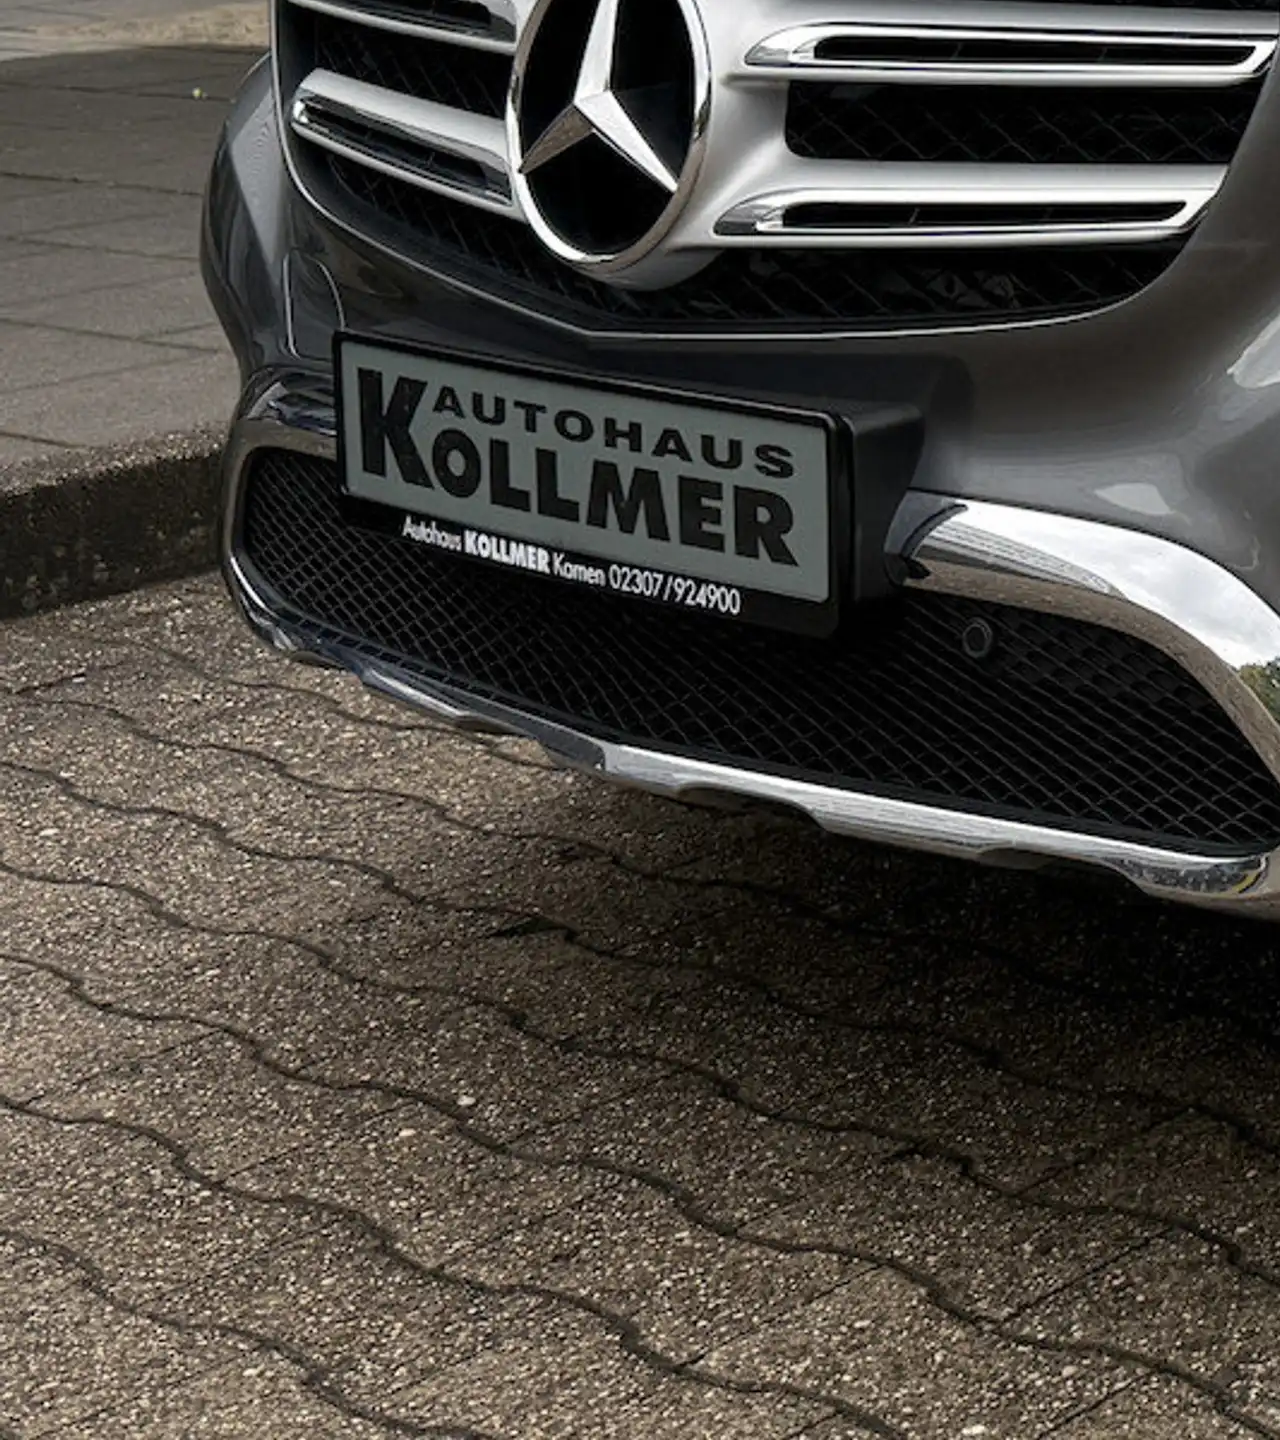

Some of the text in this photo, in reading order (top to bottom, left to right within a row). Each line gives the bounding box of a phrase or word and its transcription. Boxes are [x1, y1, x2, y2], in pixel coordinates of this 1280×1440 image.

[356, 367, 800, 568] KOLLMER
[433, 385, 796, 480] AUTOHAUS
[402, 515, 741, 616] Autohaus KOLLMER Kamen 02307/924900
